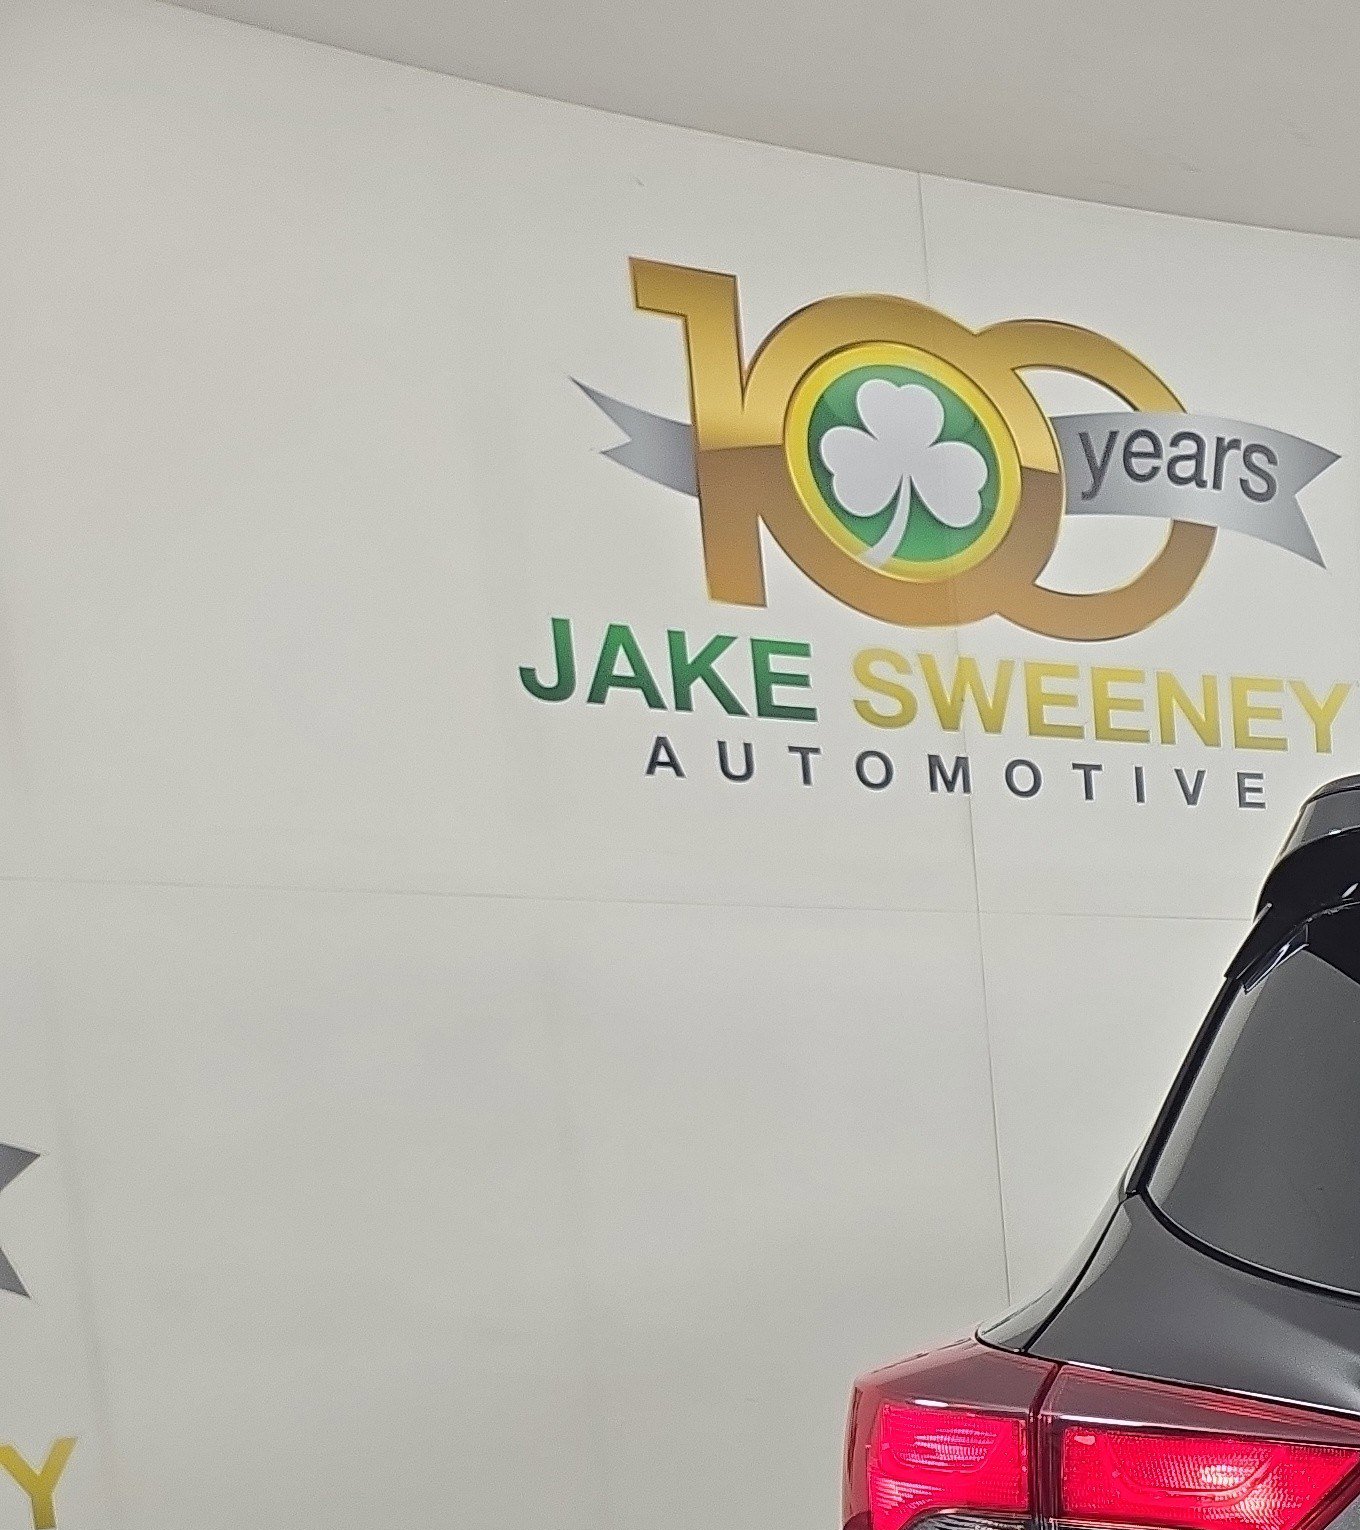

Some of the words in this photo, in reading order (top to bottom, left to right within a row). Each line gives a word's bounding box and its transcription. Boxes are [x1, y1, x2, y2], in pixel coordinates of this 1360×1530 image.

[628, 256, 1218, 643] 100
[1077, 425, 1280, 505] years
[518, 617, 818, 723] JAKE
[851, 648, 1355, 756] SWEENEY
[644, 735, 1268, 811] AUTOMOTIVE
